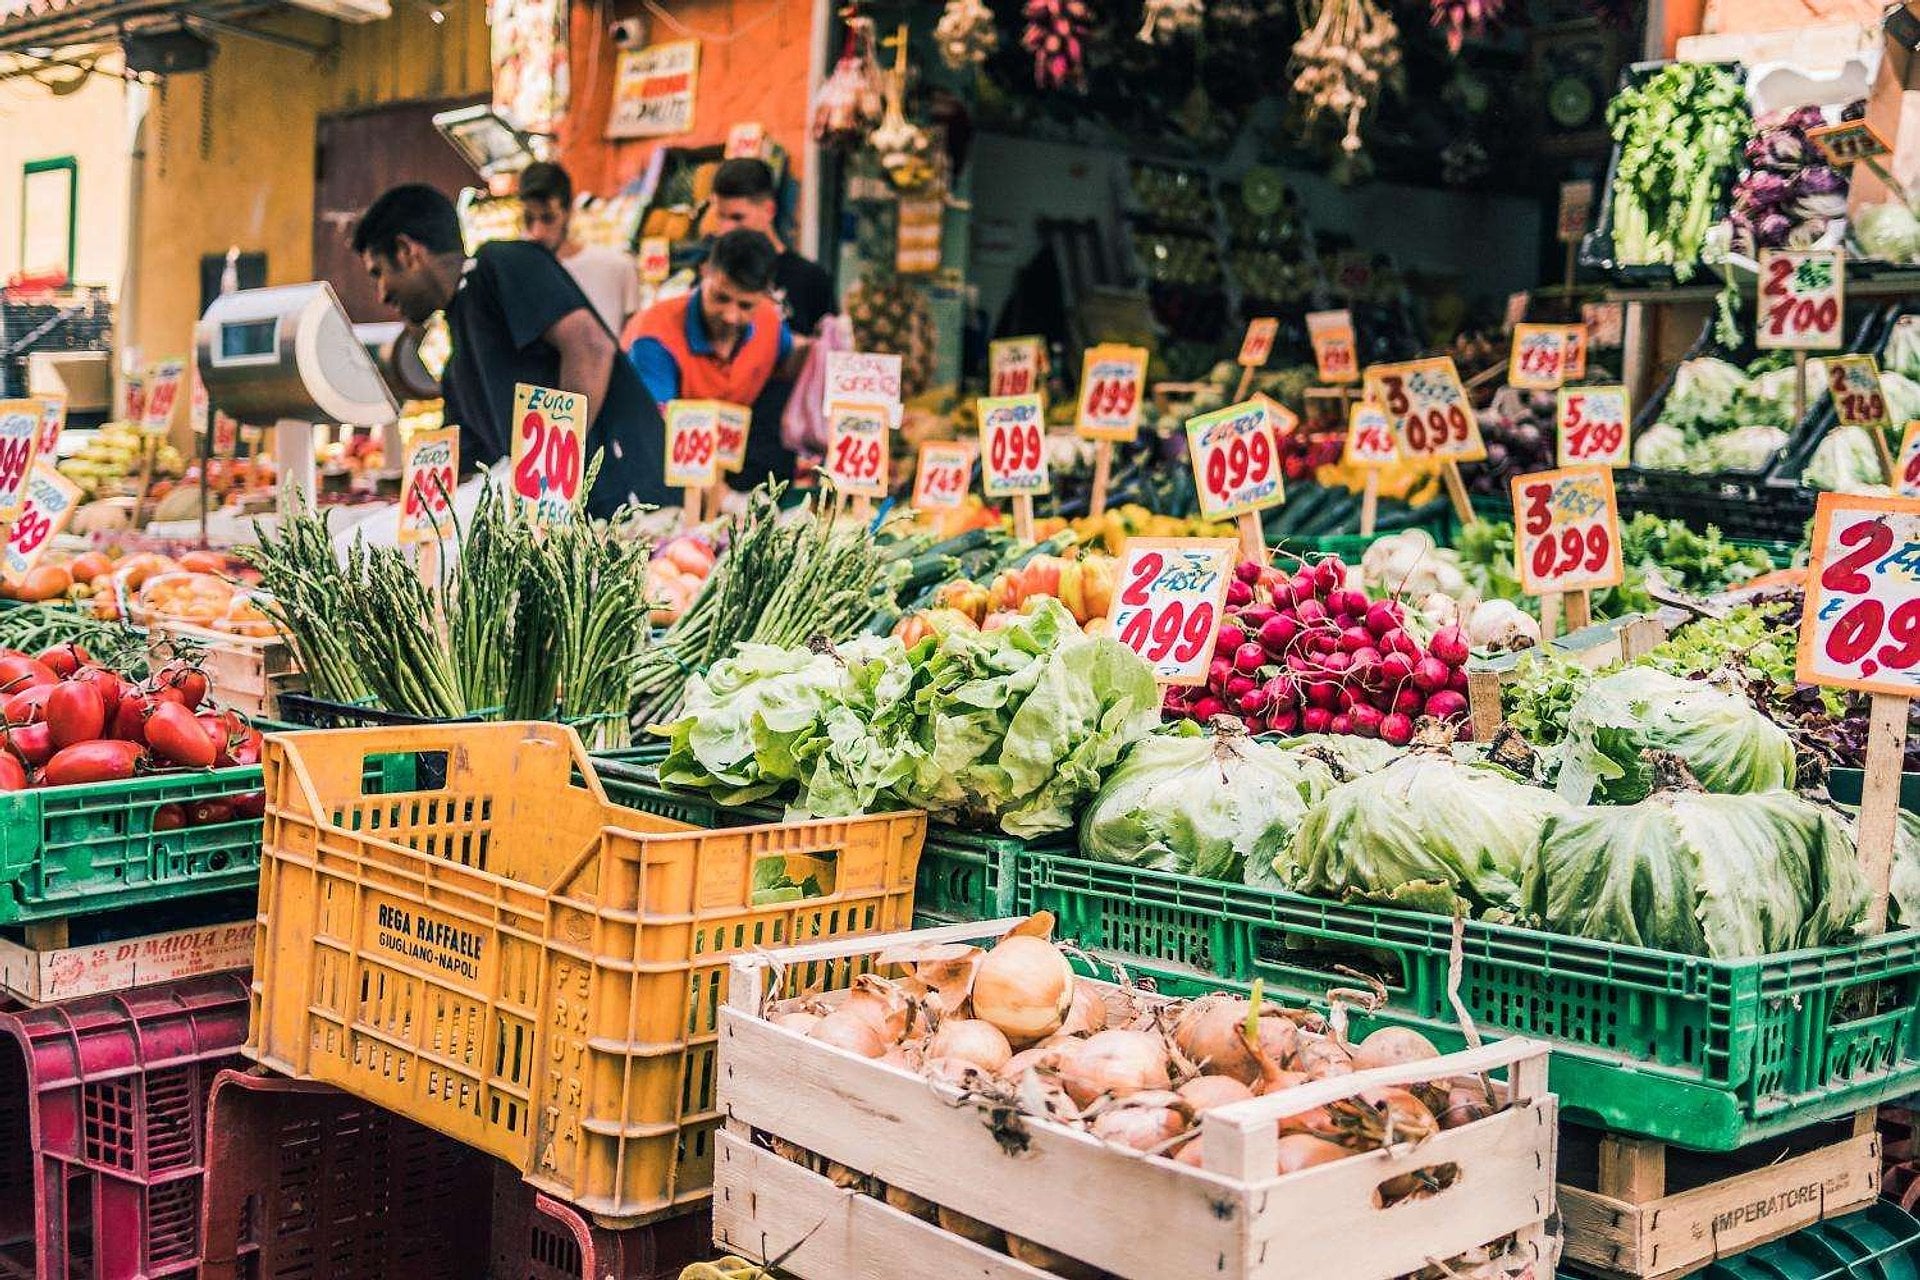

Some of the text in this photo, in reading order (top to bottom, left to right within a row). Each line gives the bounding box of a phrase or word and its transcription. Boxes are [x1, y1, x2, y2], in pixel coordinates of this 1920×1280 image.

[1764, 258, 1793, 296] 2
[1382, 376, 1409, 415] 3
[1832, 365, 1847, 392] 2
[1405, 405, 1469, 454] 0,99
[1565, 395, 1584, 428] 5
[515, 411, 580, 500] 2,00
[991, 425, 1041, 478] 0,99
[1207, 431, 1270, 501] 0,99
[1567, 423, 1624, 458] 1,99
[1524, 483, 1553, 536] 3
[1532, 524, 1610, 578] 0,99
[1822, 519, 1895, 595] 2
[1121, 552, 1164, 606] 2
[379, 903, 484, 961] REGA RAFFAELE
[379, 932, 478, 981] GIUGLIANO-NAPOLI
